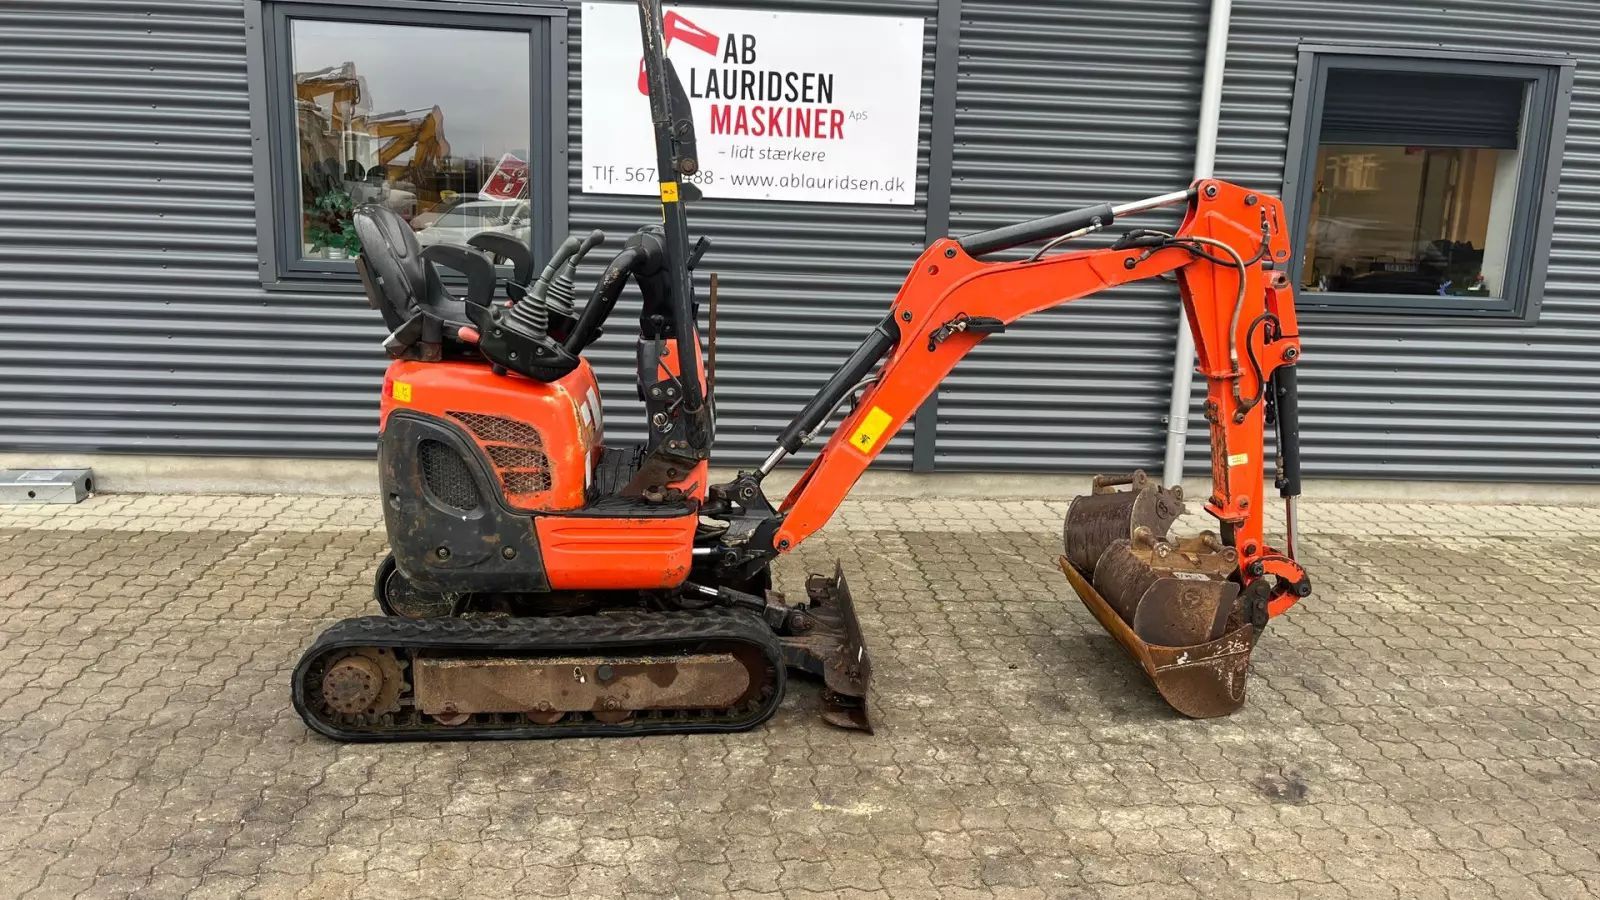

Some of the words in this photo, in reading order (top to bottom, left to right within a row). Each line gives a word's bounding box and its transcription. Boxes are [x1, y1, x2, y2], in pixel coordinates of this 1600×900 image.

[723, 33, 757, 64] AB
[690, 67, 833, 104] LAURIDSEN
[710, 104, 845, 140] MASKINER
[848, 110, 868, 121] ApS
[730, 144, 754, 160] lidt
[758, 147, 826, 162] stærkere
[592, 165, 619, 184] Tlf.
[625, 167, 660, 183] 567
[730, 173, 905, 192] www.ablauridsen.dk
